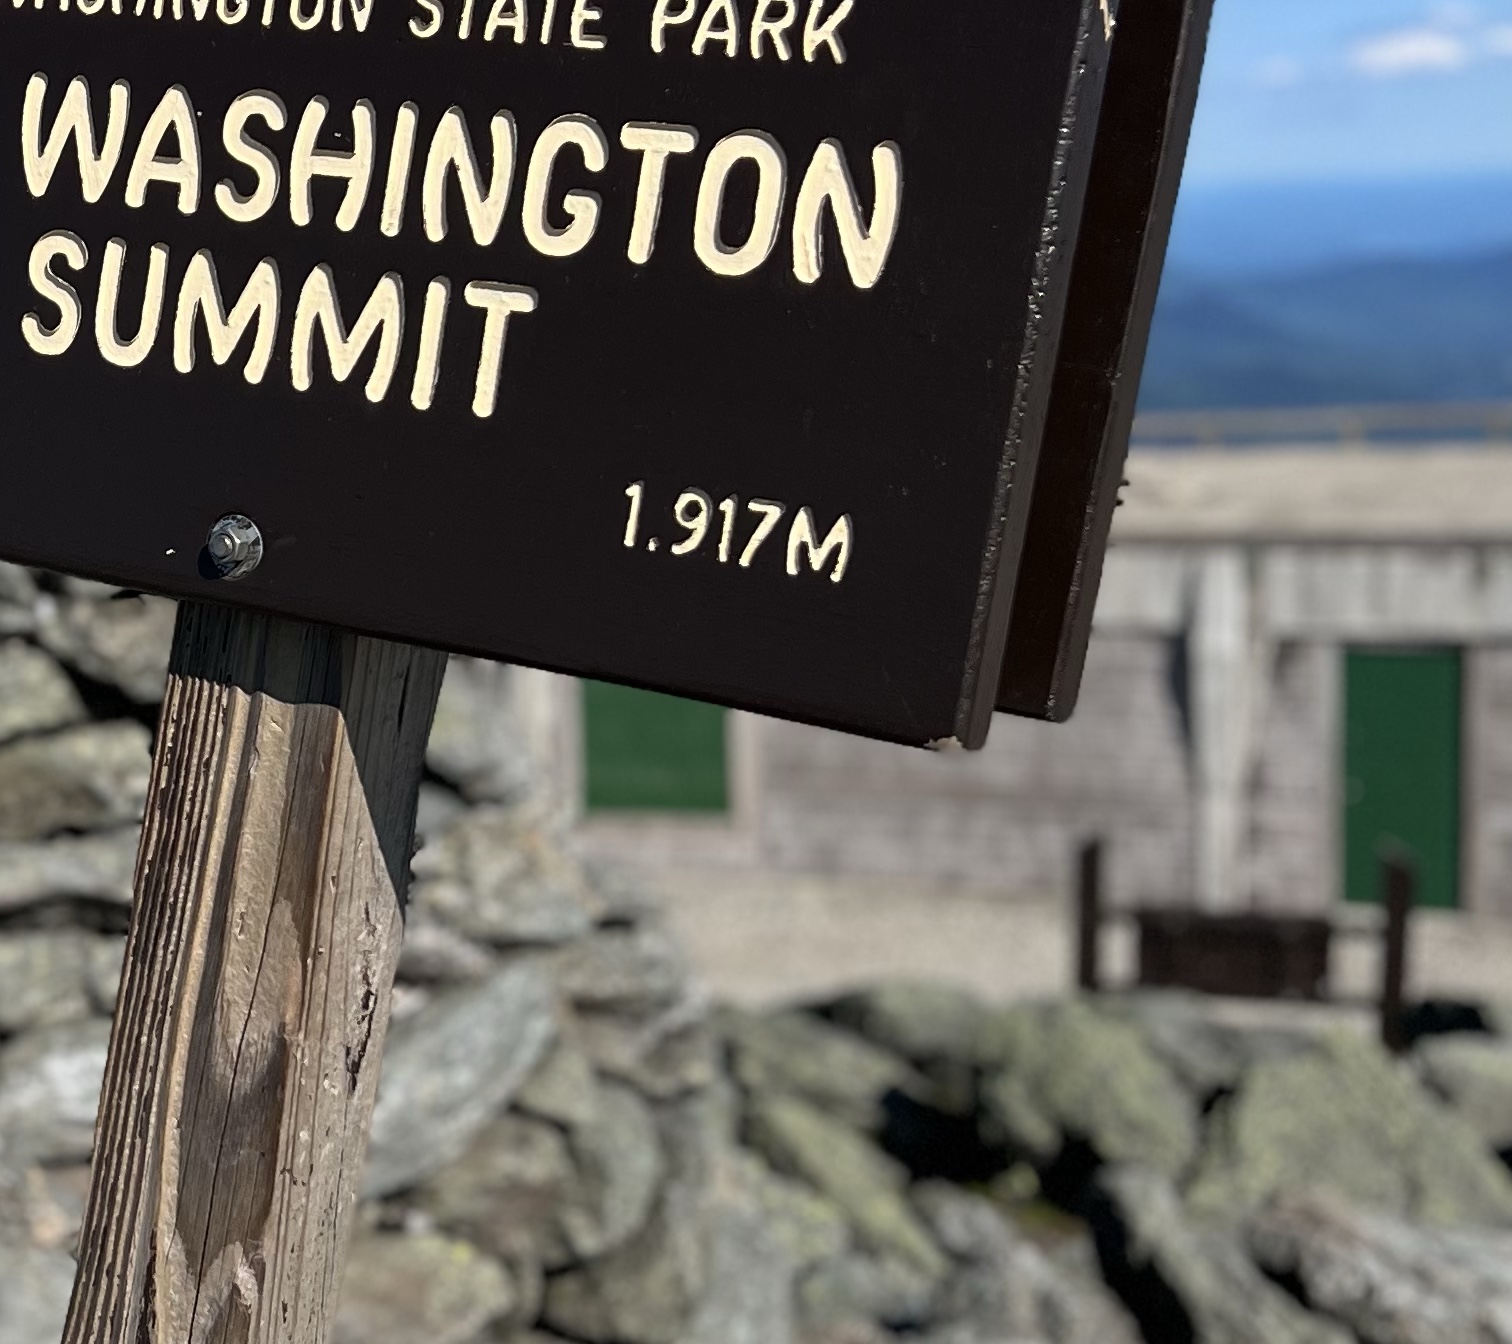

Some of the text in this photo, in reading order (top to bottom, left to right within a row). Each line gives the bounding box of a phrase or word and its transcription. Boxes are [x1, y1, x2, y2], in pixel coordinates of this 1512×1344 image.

[19, 72, 901, 290] WASHINGTON
[19, 229, 536, 419] SUMMIT
[621, 482, 851, 584] 1.917M
